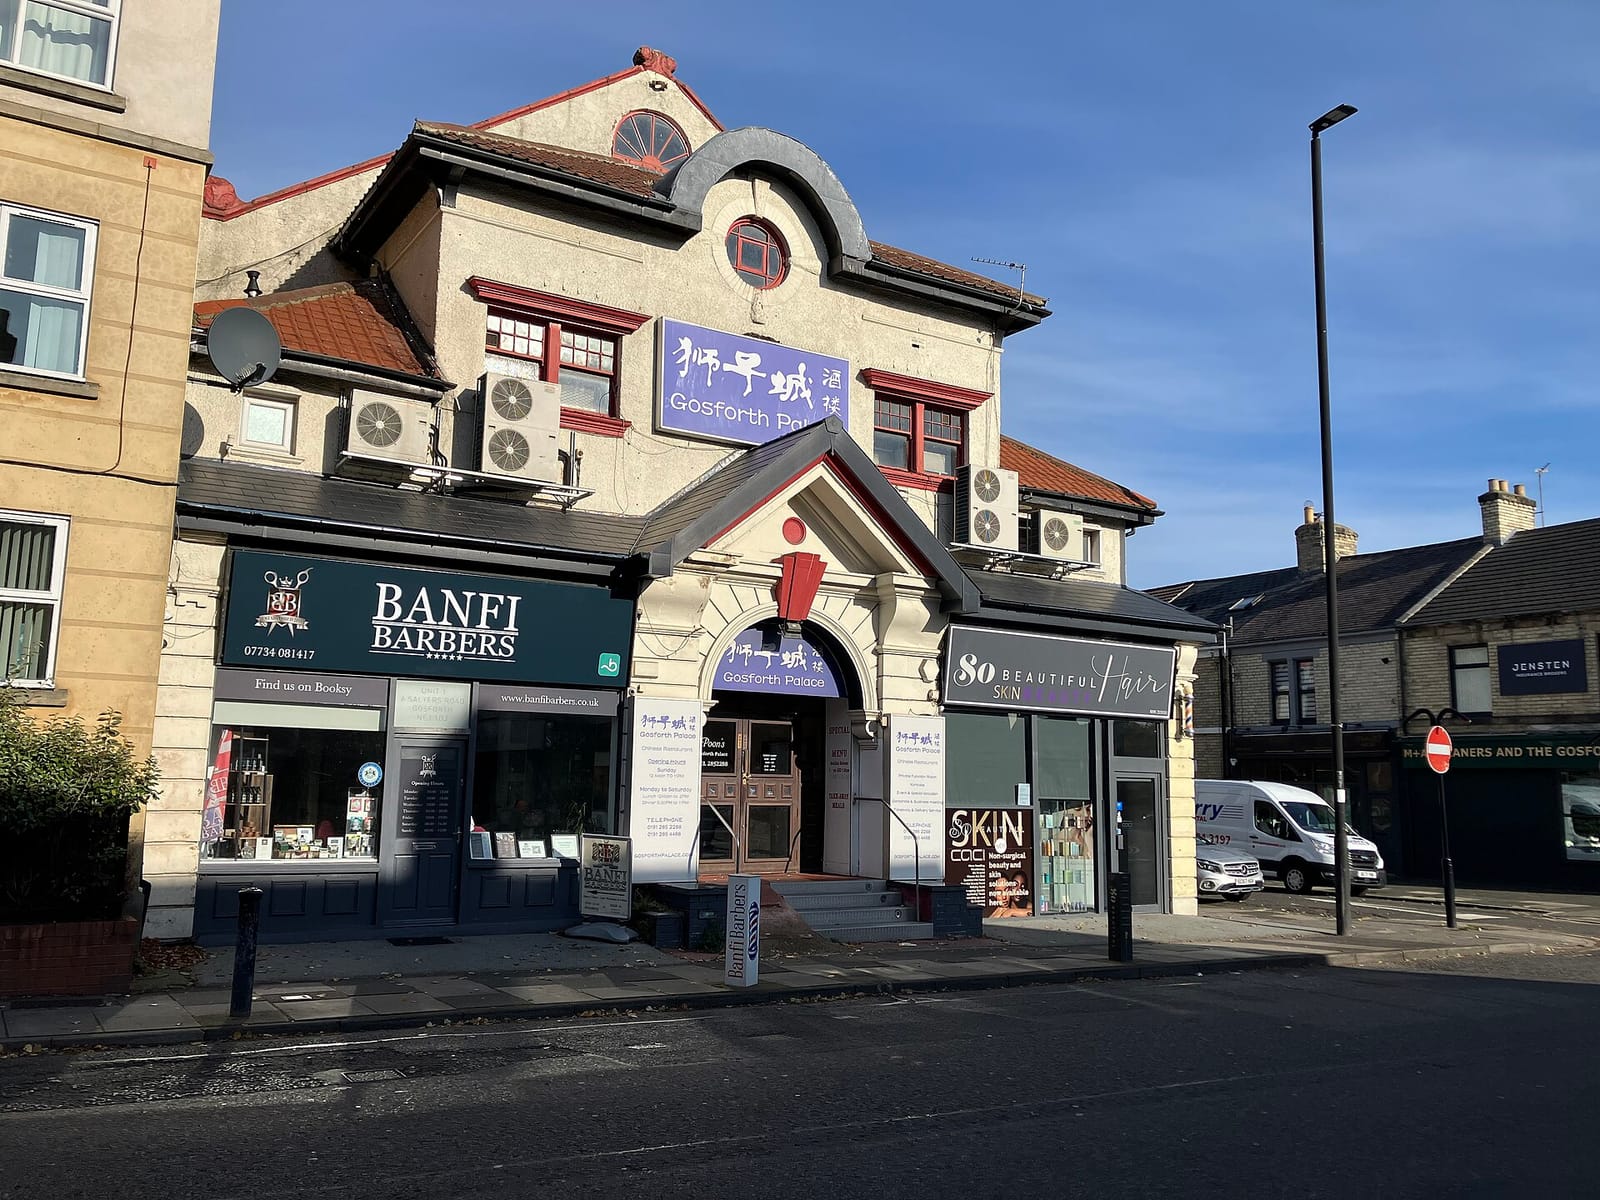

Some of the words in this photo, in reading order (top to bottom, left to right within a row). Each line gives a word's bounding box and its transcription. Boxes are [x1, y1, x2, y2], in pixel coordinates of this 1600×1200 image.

[670, 391, 770, 428] Gosforth
[372, 582, 522, 632] BANFI
[371, 625, 516, 658] BARBERS
[244, 645, 276, 658] 07734
[278, 648, 315, 660] 081417
[1512, 660, 1570, 672] JENSTEN
[255, 678, 280, 691] Find
[283, 681, 295, 691] us
[298, 683, 311, 692] on
[315, 682, 352, 697] Booksy
[723, 671, 781, 685] Gosforth
[785, 675, 825, 688] Palace
[1002, 669, 1097, 689] BEAUTIFUL
[1091, 654, 1168, 704] Hair
[501, 693, 600, 708] www.banfibarbers.co.uk
[993, 684, 1021, 700] SKIN
[1451, 747, 1492, 758] ANERS
[1496, 746, 1522, 757] AND
[1526, 746, 1552, 757] THE
[1195, 803, 1224, 820] rry
[952, 809, 1023, 848] SKIN
[988, 852, 1026, 862] Non-surgical
[584, 867, 627, 882] BANFI
[988, 861, 1009, 871] beauty
[1010, 861, 1021, 869] and
[729, 883, 746, 939] Barbers
[728, 940, 744, 979] Banfi
